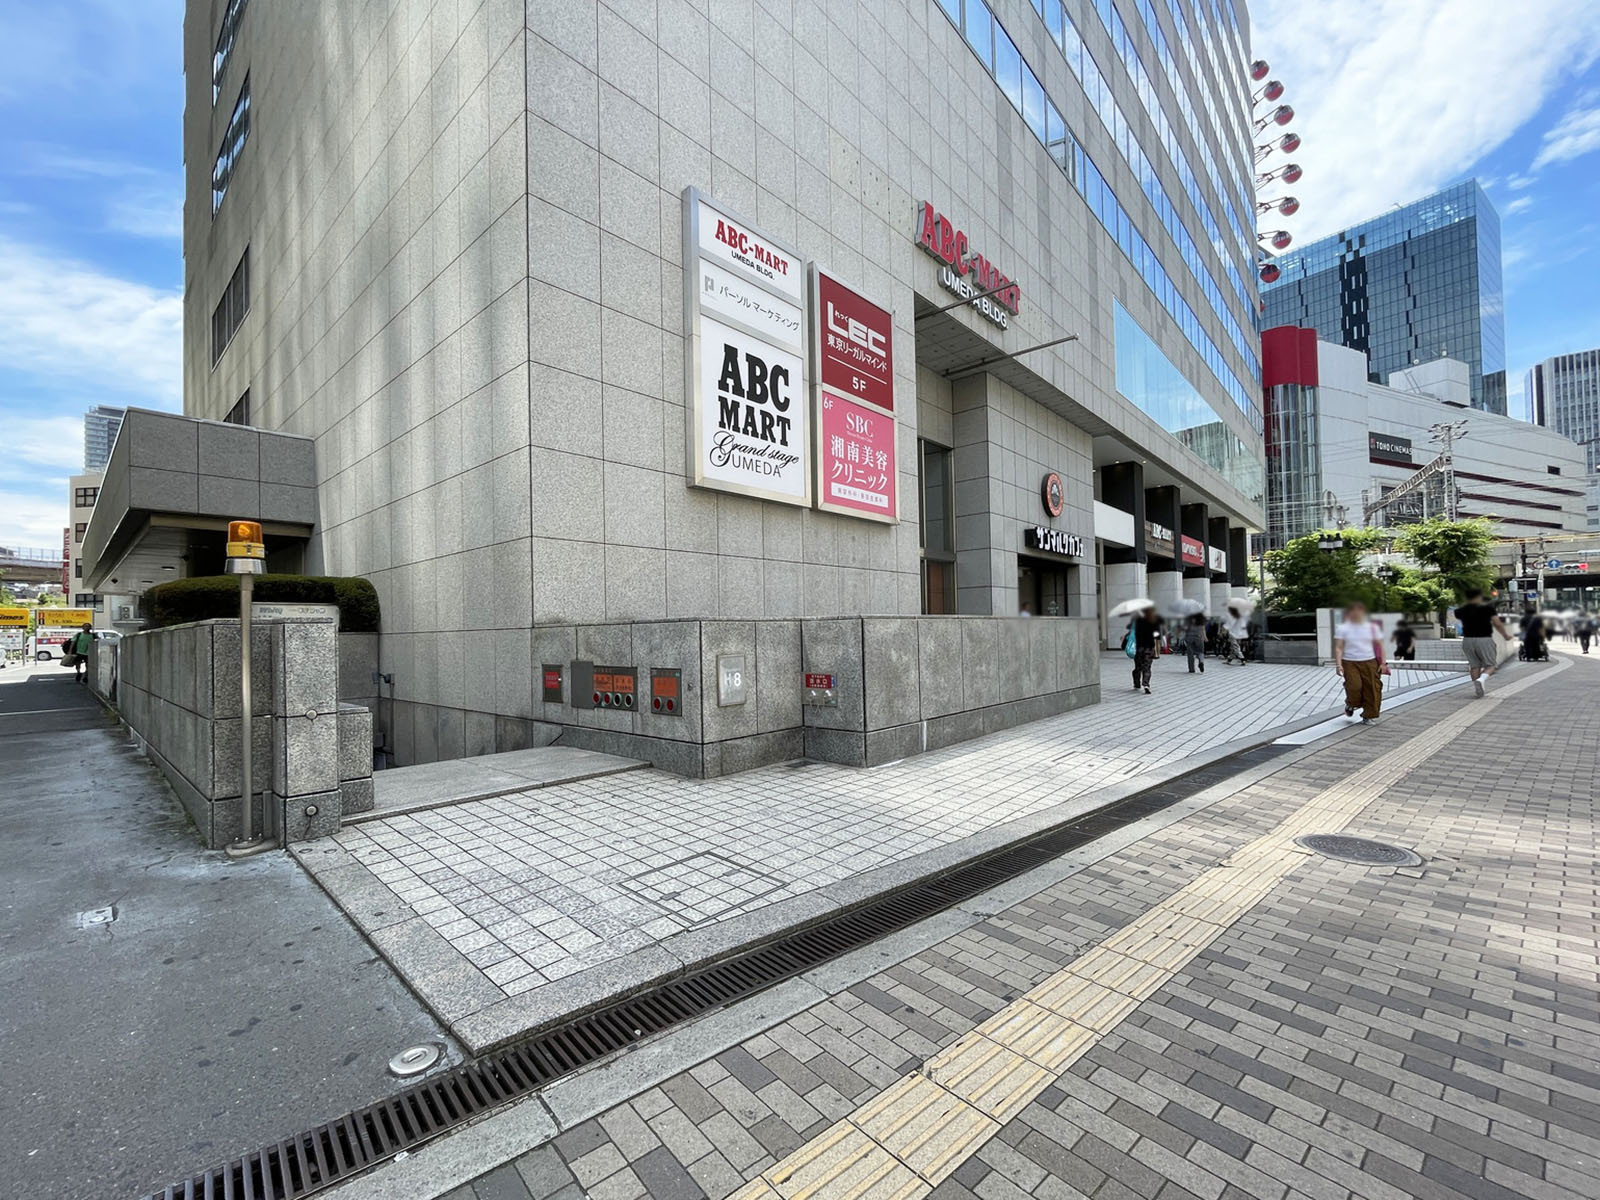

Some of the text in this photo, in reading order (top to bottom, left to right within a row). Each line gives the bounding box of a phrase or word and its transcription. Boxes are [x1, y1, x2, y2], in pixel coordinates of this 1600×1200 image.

[715, 219, 788, 276] ABC-MART
[731, 250, 775, 281] UMEDA BLDG.
[827, 300, 886, 358] LEC
[827, 333, 888, 373] 東京リーガルマインド
[717, 343, 790, 412] ABC
[852, 376, 867, 392] 5F
[823, 397, 834, 410] 6F
[717, 395, 791, 447] MART
[846, 411, 874, 439] SBC
[709, 431, 800, 469] Grand stage
[731, 453, 782, 478] UMEDA
[831, 434, 888, 472] 湘南美容
[831, 459, 888, 490] クリニック
[1036, 526, 1084, 557] サンマルクカフェ
